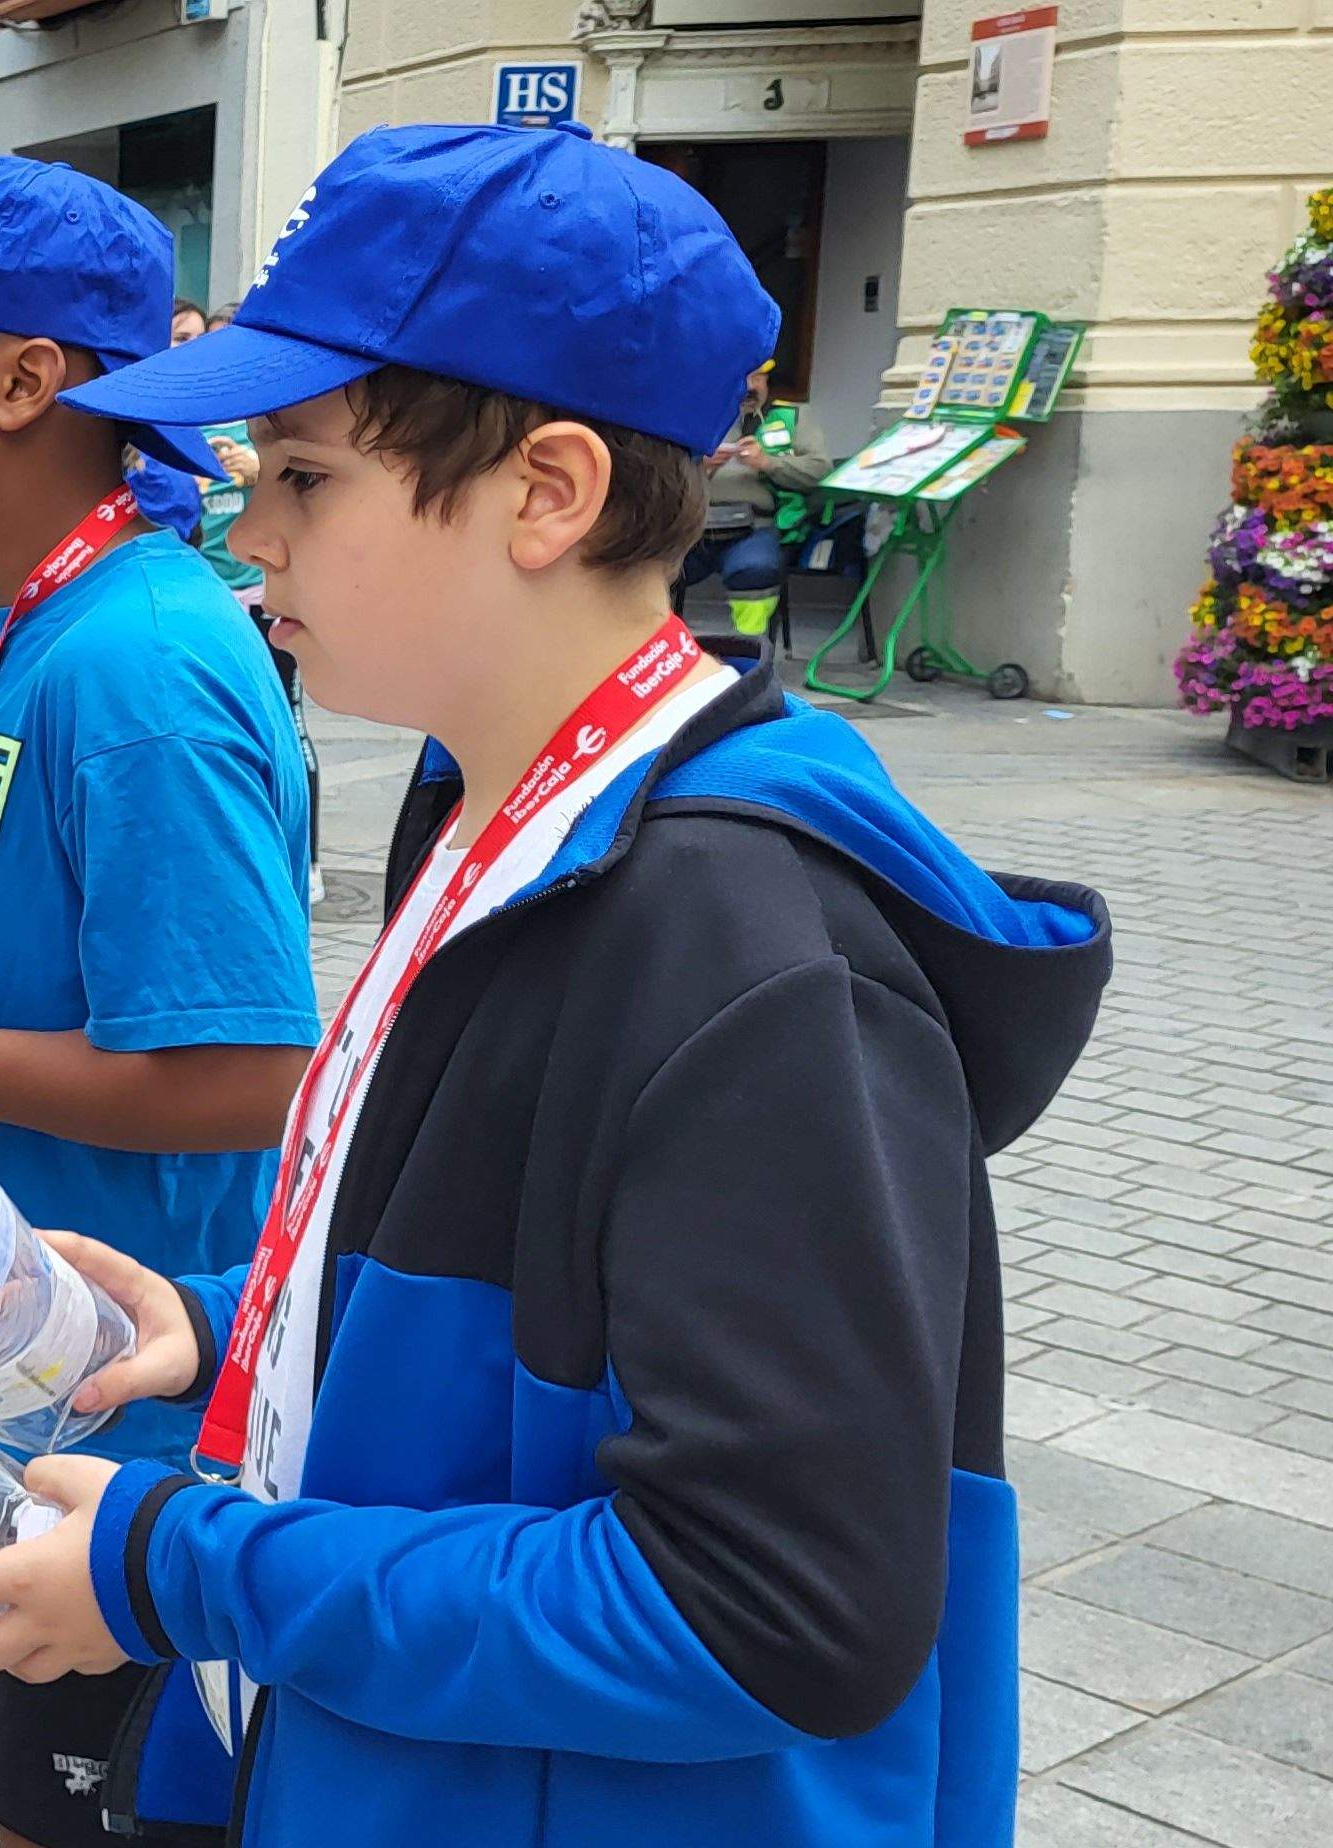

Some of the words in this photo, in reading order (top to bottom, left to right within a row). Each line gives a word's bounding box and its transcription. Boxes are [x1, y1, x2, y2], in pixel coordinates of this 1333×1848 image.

[502, 72, 568, 113] HS
[617, 639, 669, 685] Fundación
[630, 652, 684, 699] iberCaja
[503, 754, 555, 817] Fundación
[510, 761, 572, 825] iberCaja
